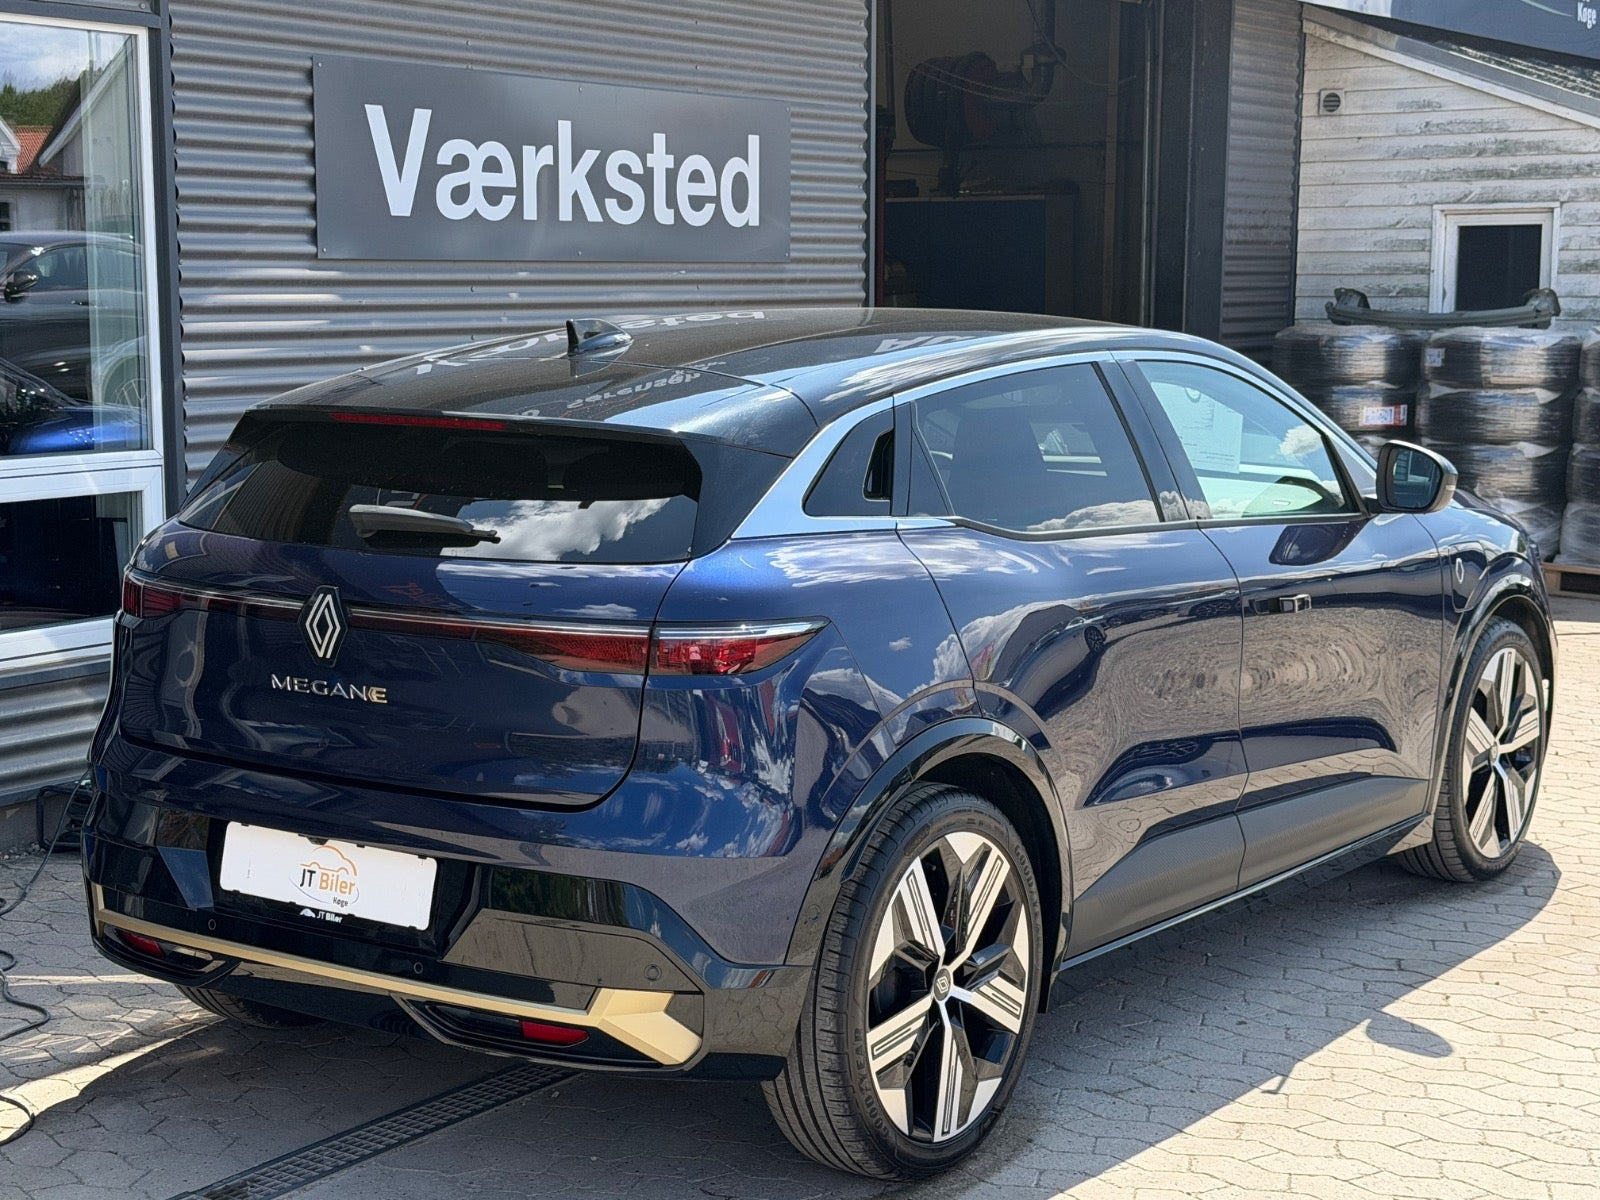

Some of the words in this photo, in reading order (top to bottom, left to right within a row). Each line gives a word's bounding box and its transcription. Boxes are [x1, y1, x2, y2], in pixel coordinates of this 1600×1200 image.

[1577, 2, 1597, 29] Køge
[364, 104, 760, 228] Værksted
[271, 673, 388, 704] MEGANE
[300, 868, 316, 888] JT
[319, 871, 356, 896] Biler
[317, 911, 326, 920] JT
